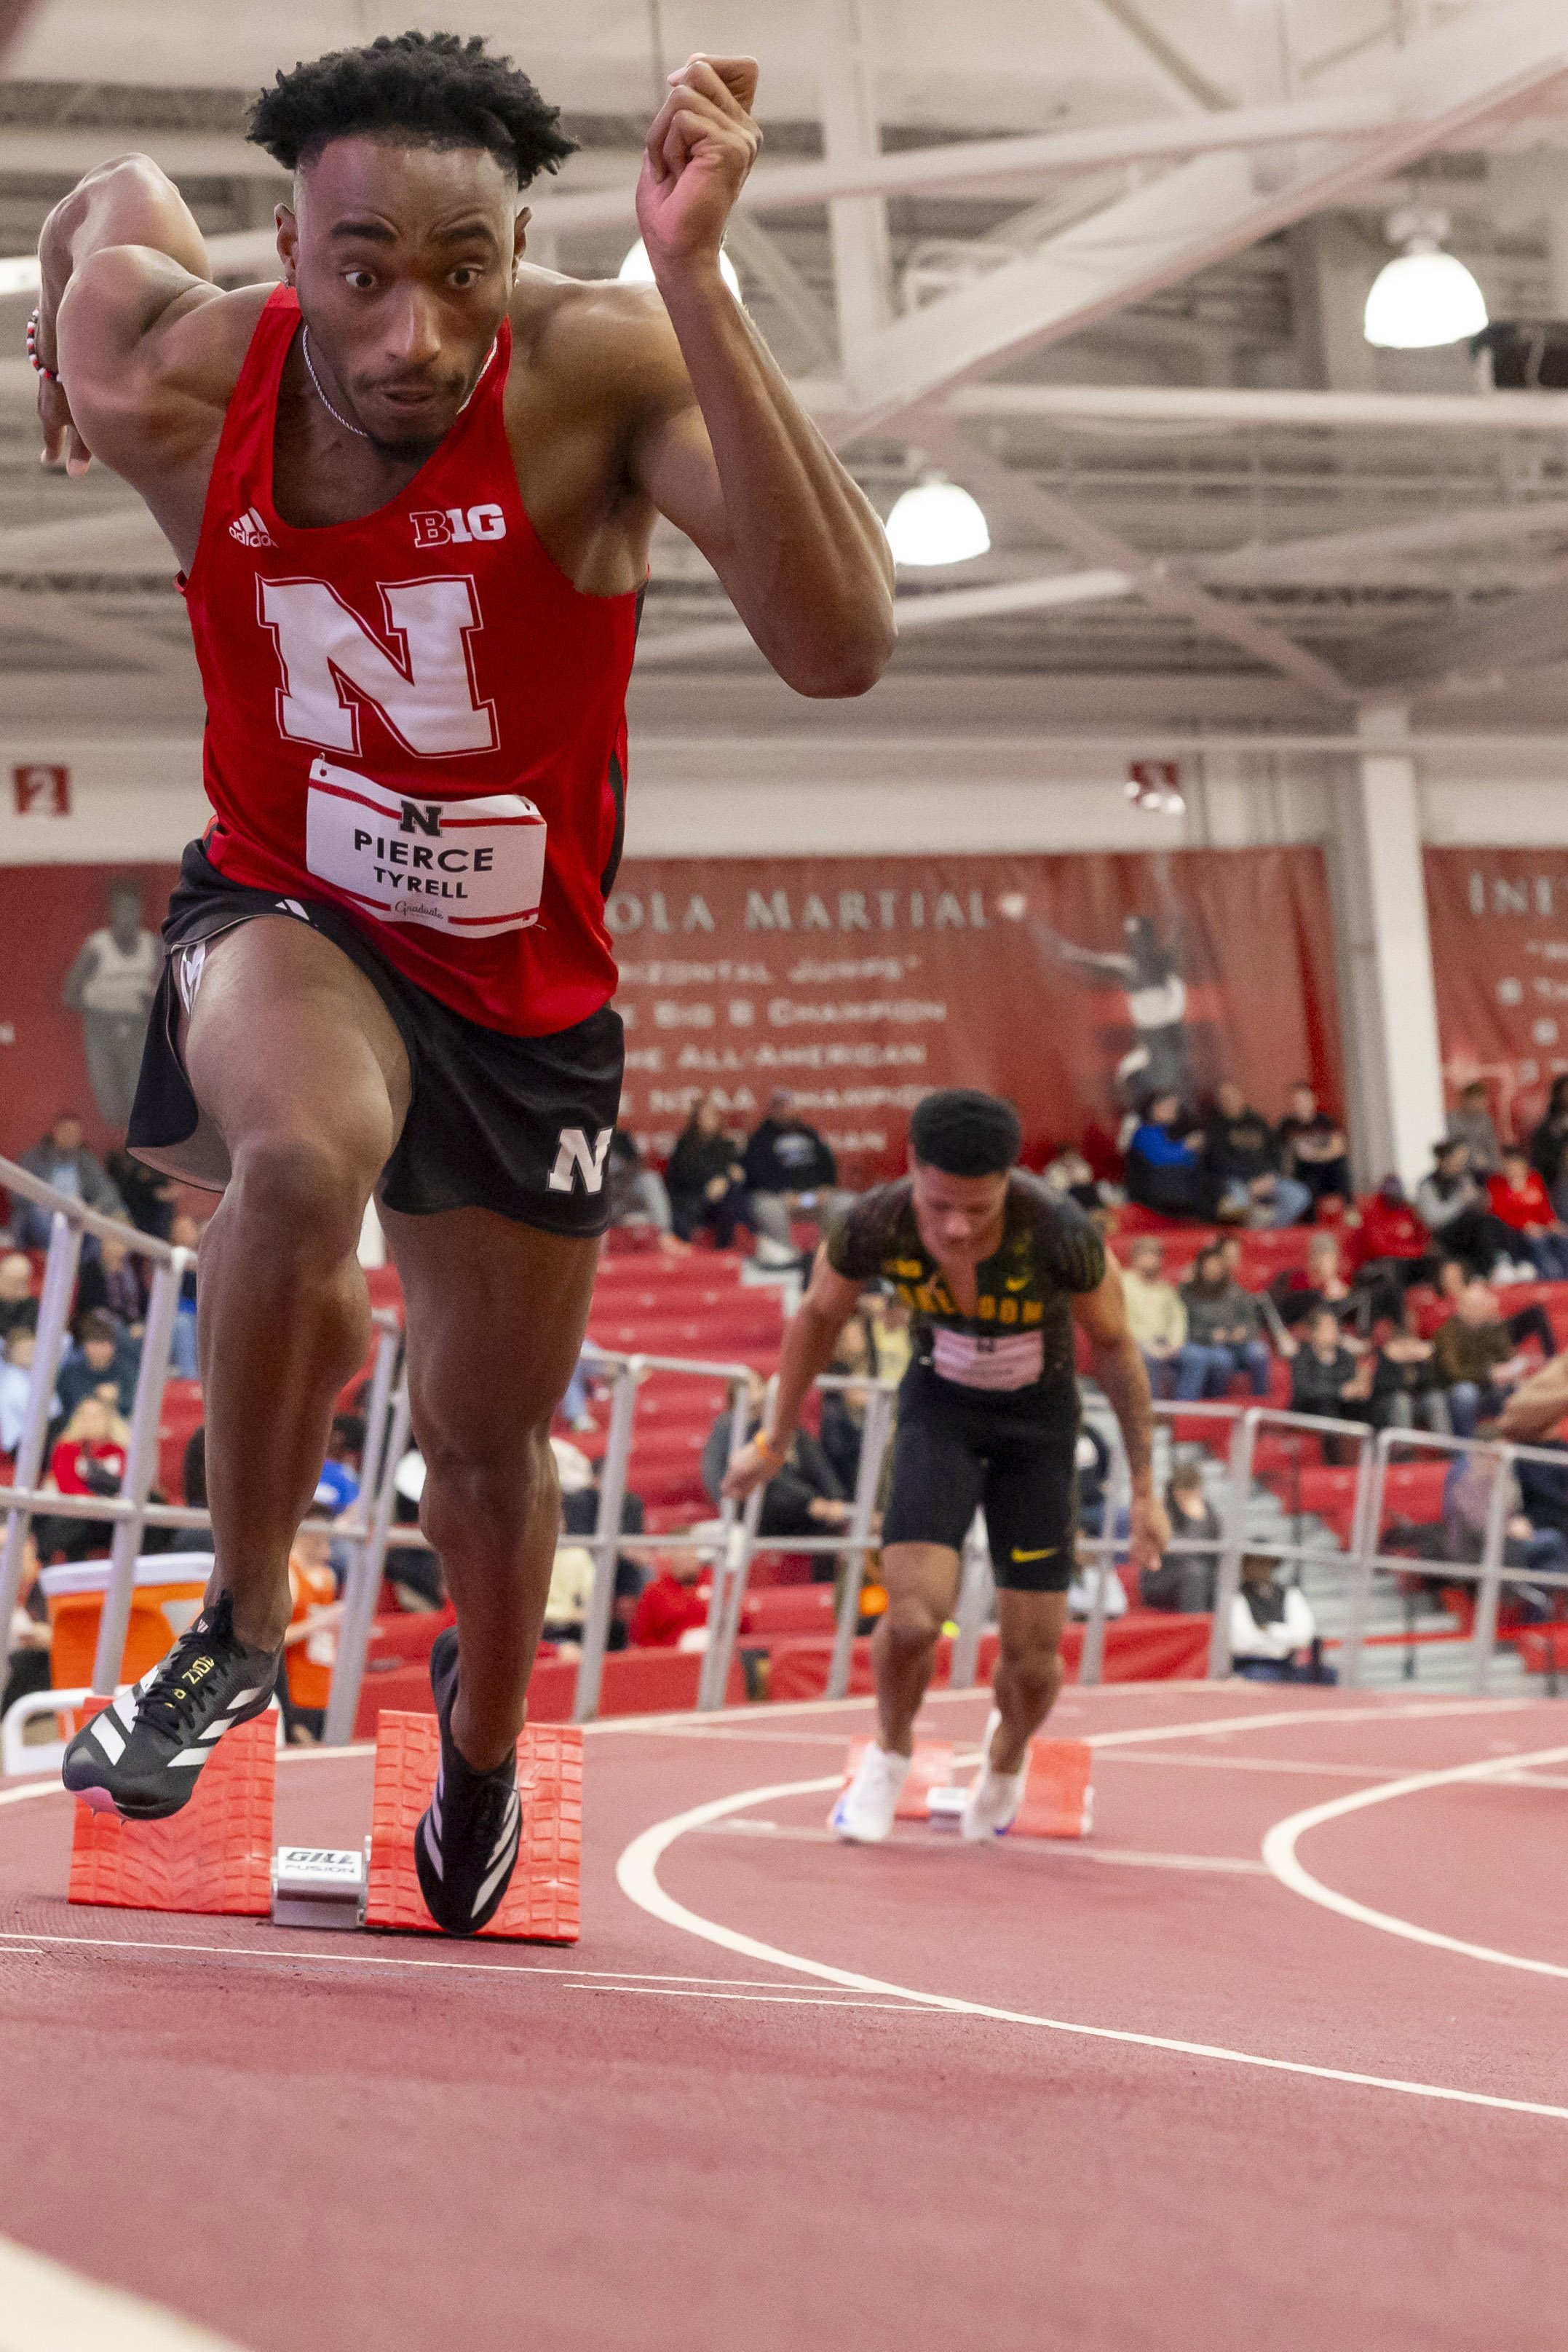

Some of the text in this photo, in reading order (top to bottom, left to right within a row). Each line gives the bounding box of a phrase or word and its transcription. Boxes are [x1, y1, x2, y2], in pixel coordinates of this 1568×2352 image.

[229, 526, 279, 547] adida
[255, 571, 501, 759] N
[400, 799, 443, 837] N
[354, 828, 494, 873] PIERCE
[373, 866, 468, 899] TYRELL
[395, 900, 444, 920] Graduate
[744, 888, 991, 932] MARTIAL
[546, 1125, 614, 1195] N
[285, 1851, 355, 1864] GILL
[285, 1864, 356, 1874] FUSION
